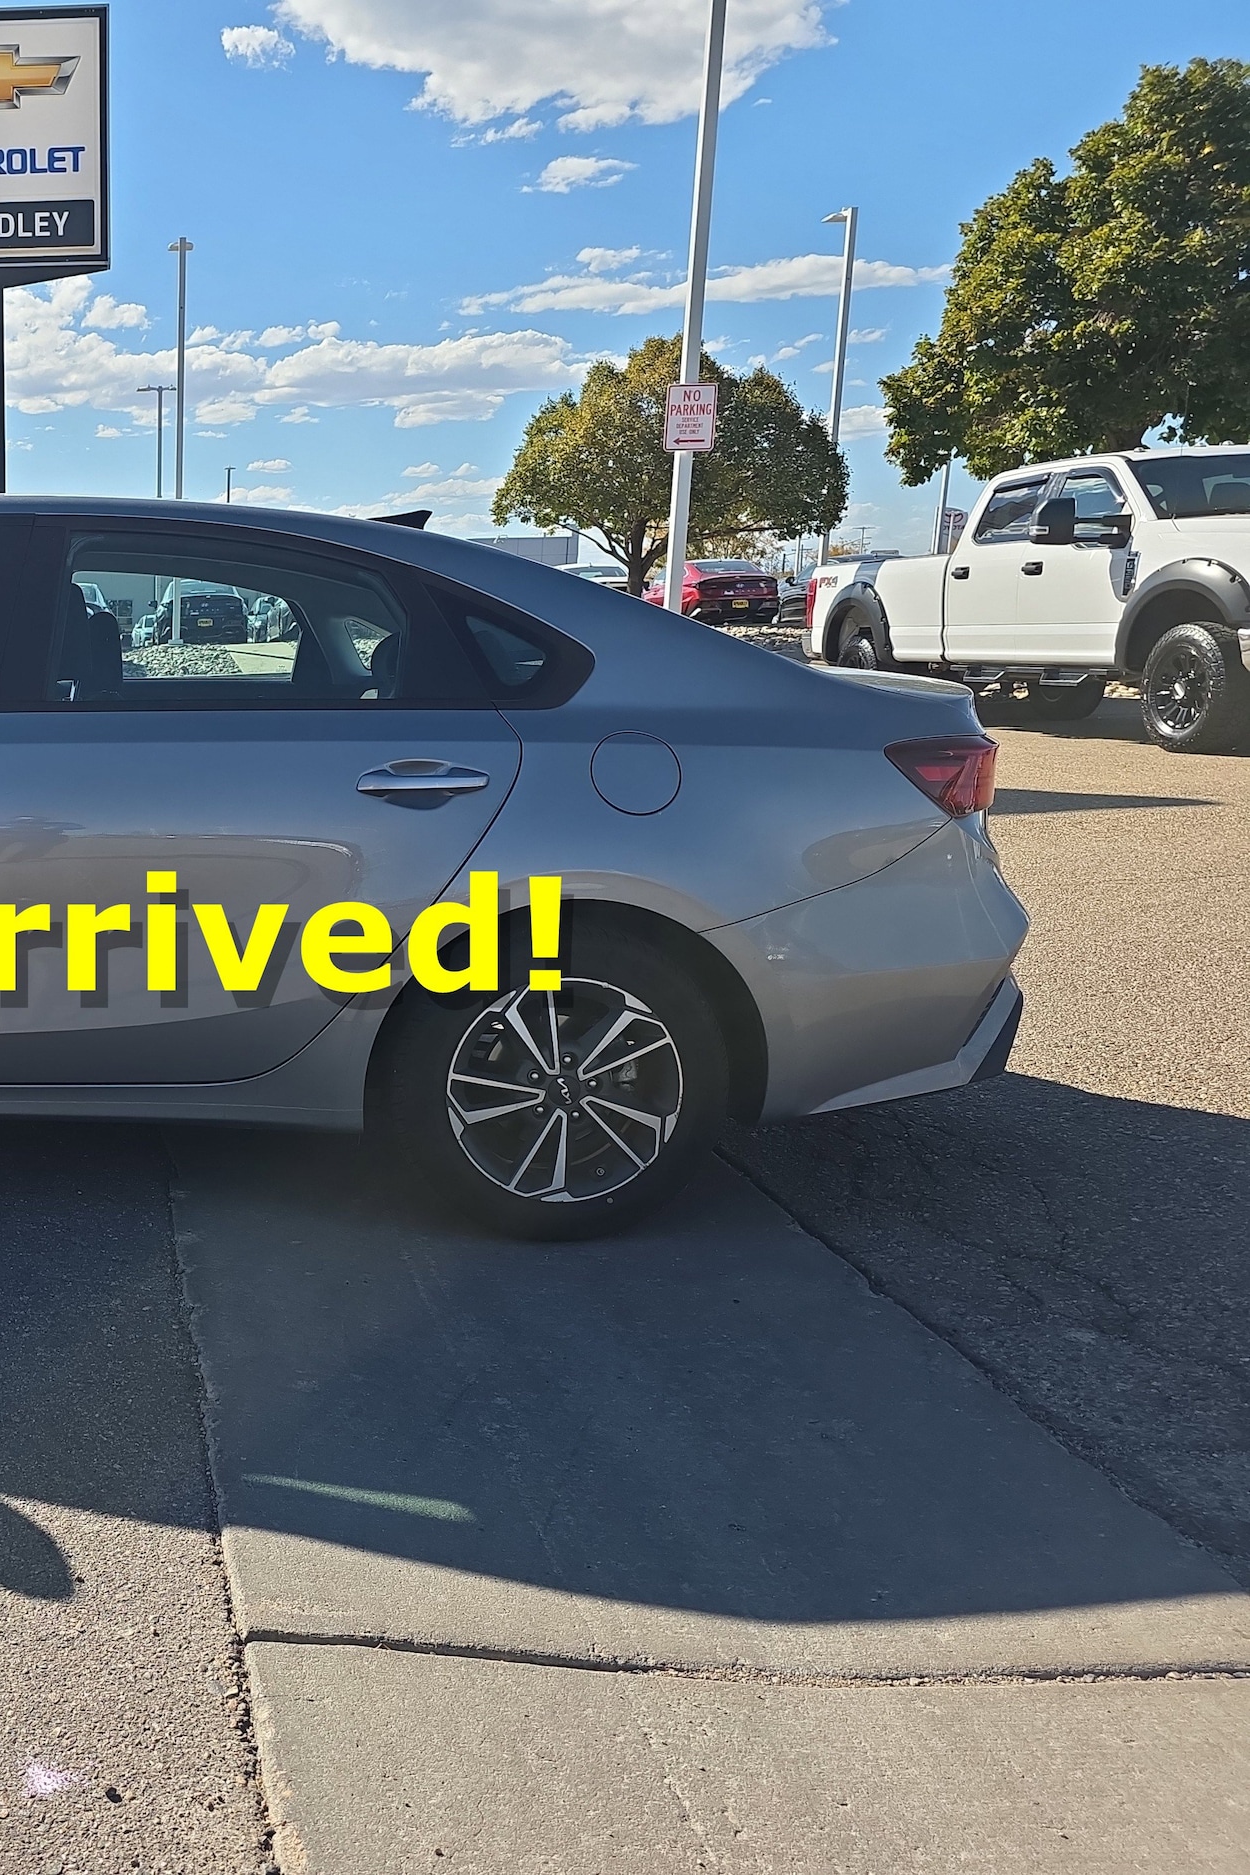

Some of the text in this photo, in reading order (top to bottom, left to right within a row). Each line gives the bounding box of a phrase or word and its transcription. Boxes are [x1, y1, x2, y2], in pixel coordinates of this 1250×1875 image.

[683, 389, 701, 402] NO
[670, 403, 712, 416] PARKING
[819, 576, 838, 588] FX4
